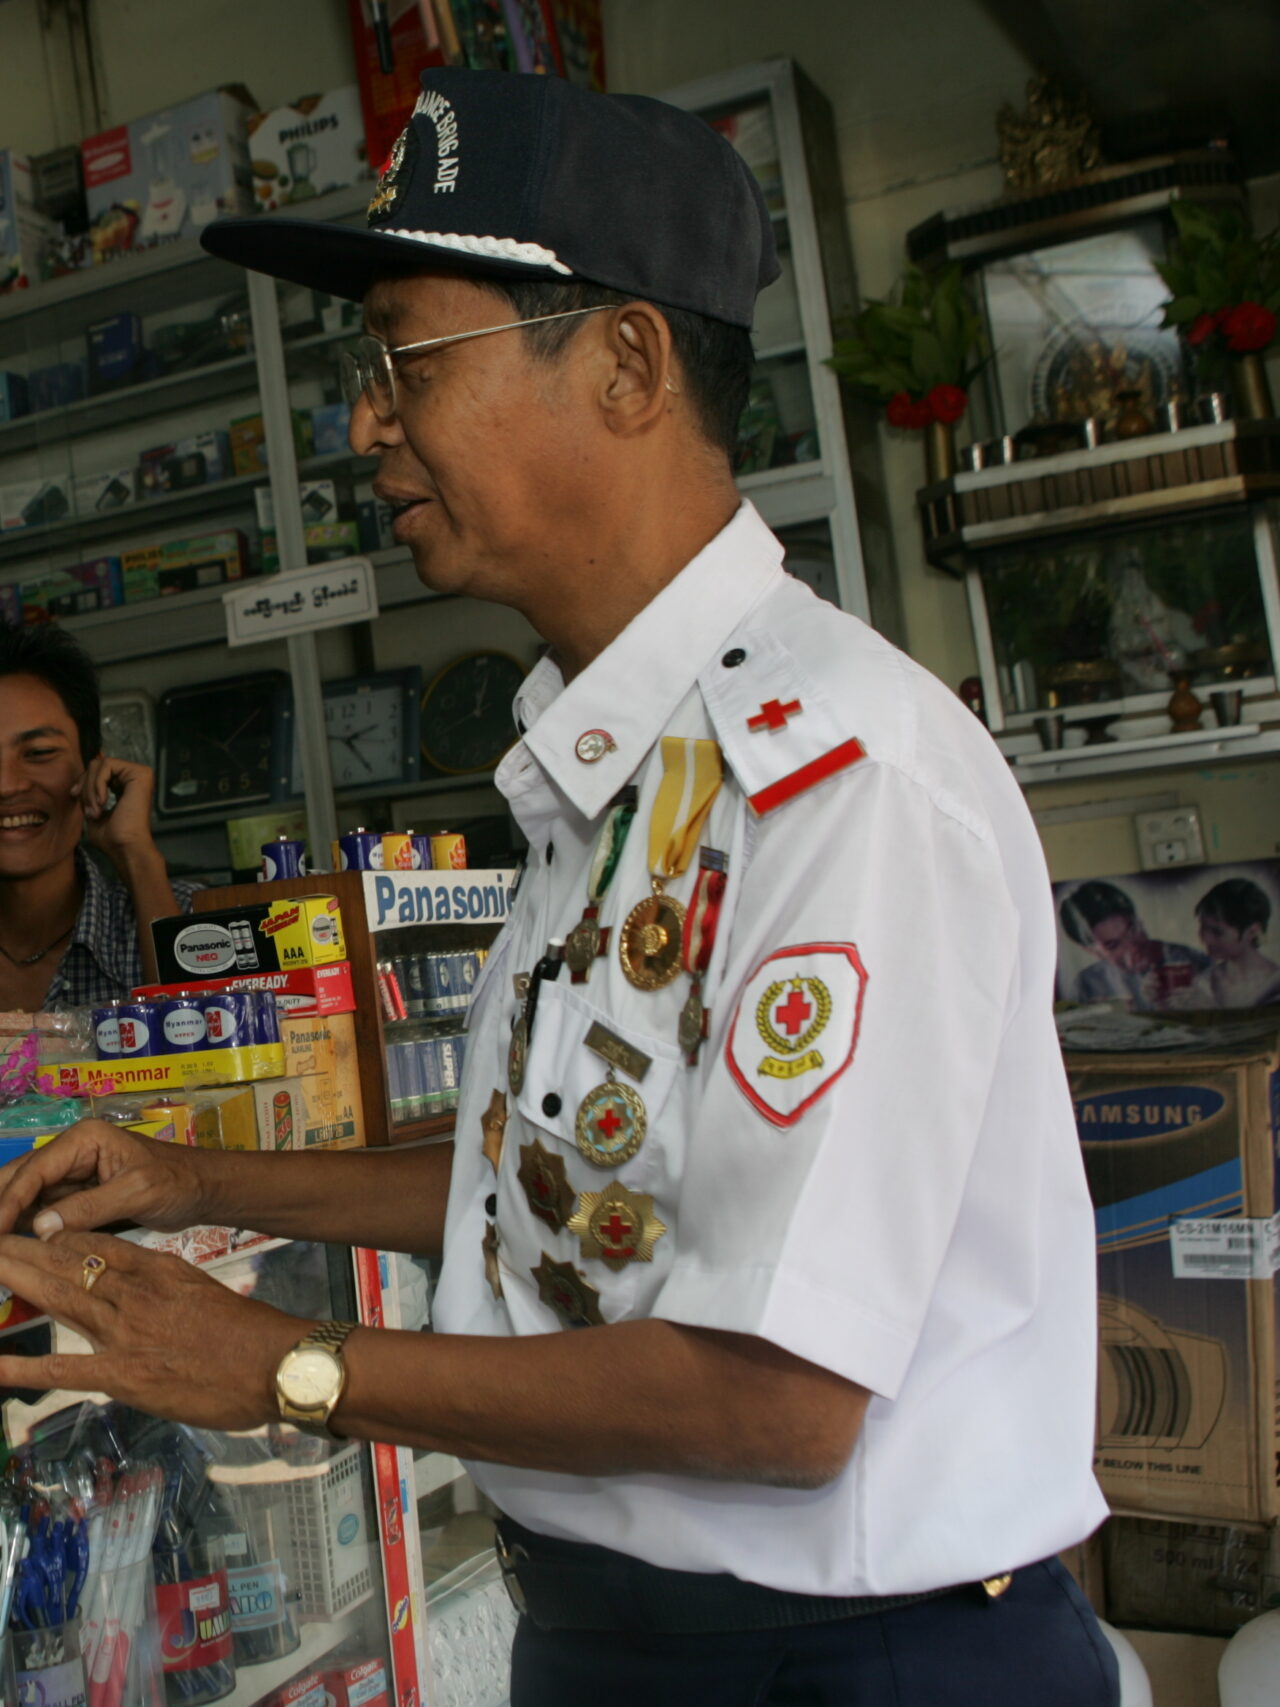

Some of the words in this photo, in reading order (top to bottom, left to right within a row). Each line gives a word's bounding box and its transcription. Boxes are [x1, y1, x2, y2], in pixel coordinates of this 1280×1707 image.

[278, 114, 339, 145] PHILIPS
[180, 938, 232, 953] Panasonic
[196, 953, 218, 962] NEO
[283, 946, 305, 961] AAA
[165, 1018, 202, 1029] Myanmar
[290, 1029, 332, 1044] Panasonic
[441, 1042, 456, 1088] SUPER
[1103, 1458, 1143, 1471] BELOW
[1147, 1461, 1173, 1473] THIS
[1176, 1464, 1202, 1475] LINE
[240, 1581, 259, 1590] PEN
[350, 1662, 380, 1682] Colgate
[288, 1675, 320, 1699] Colgate
